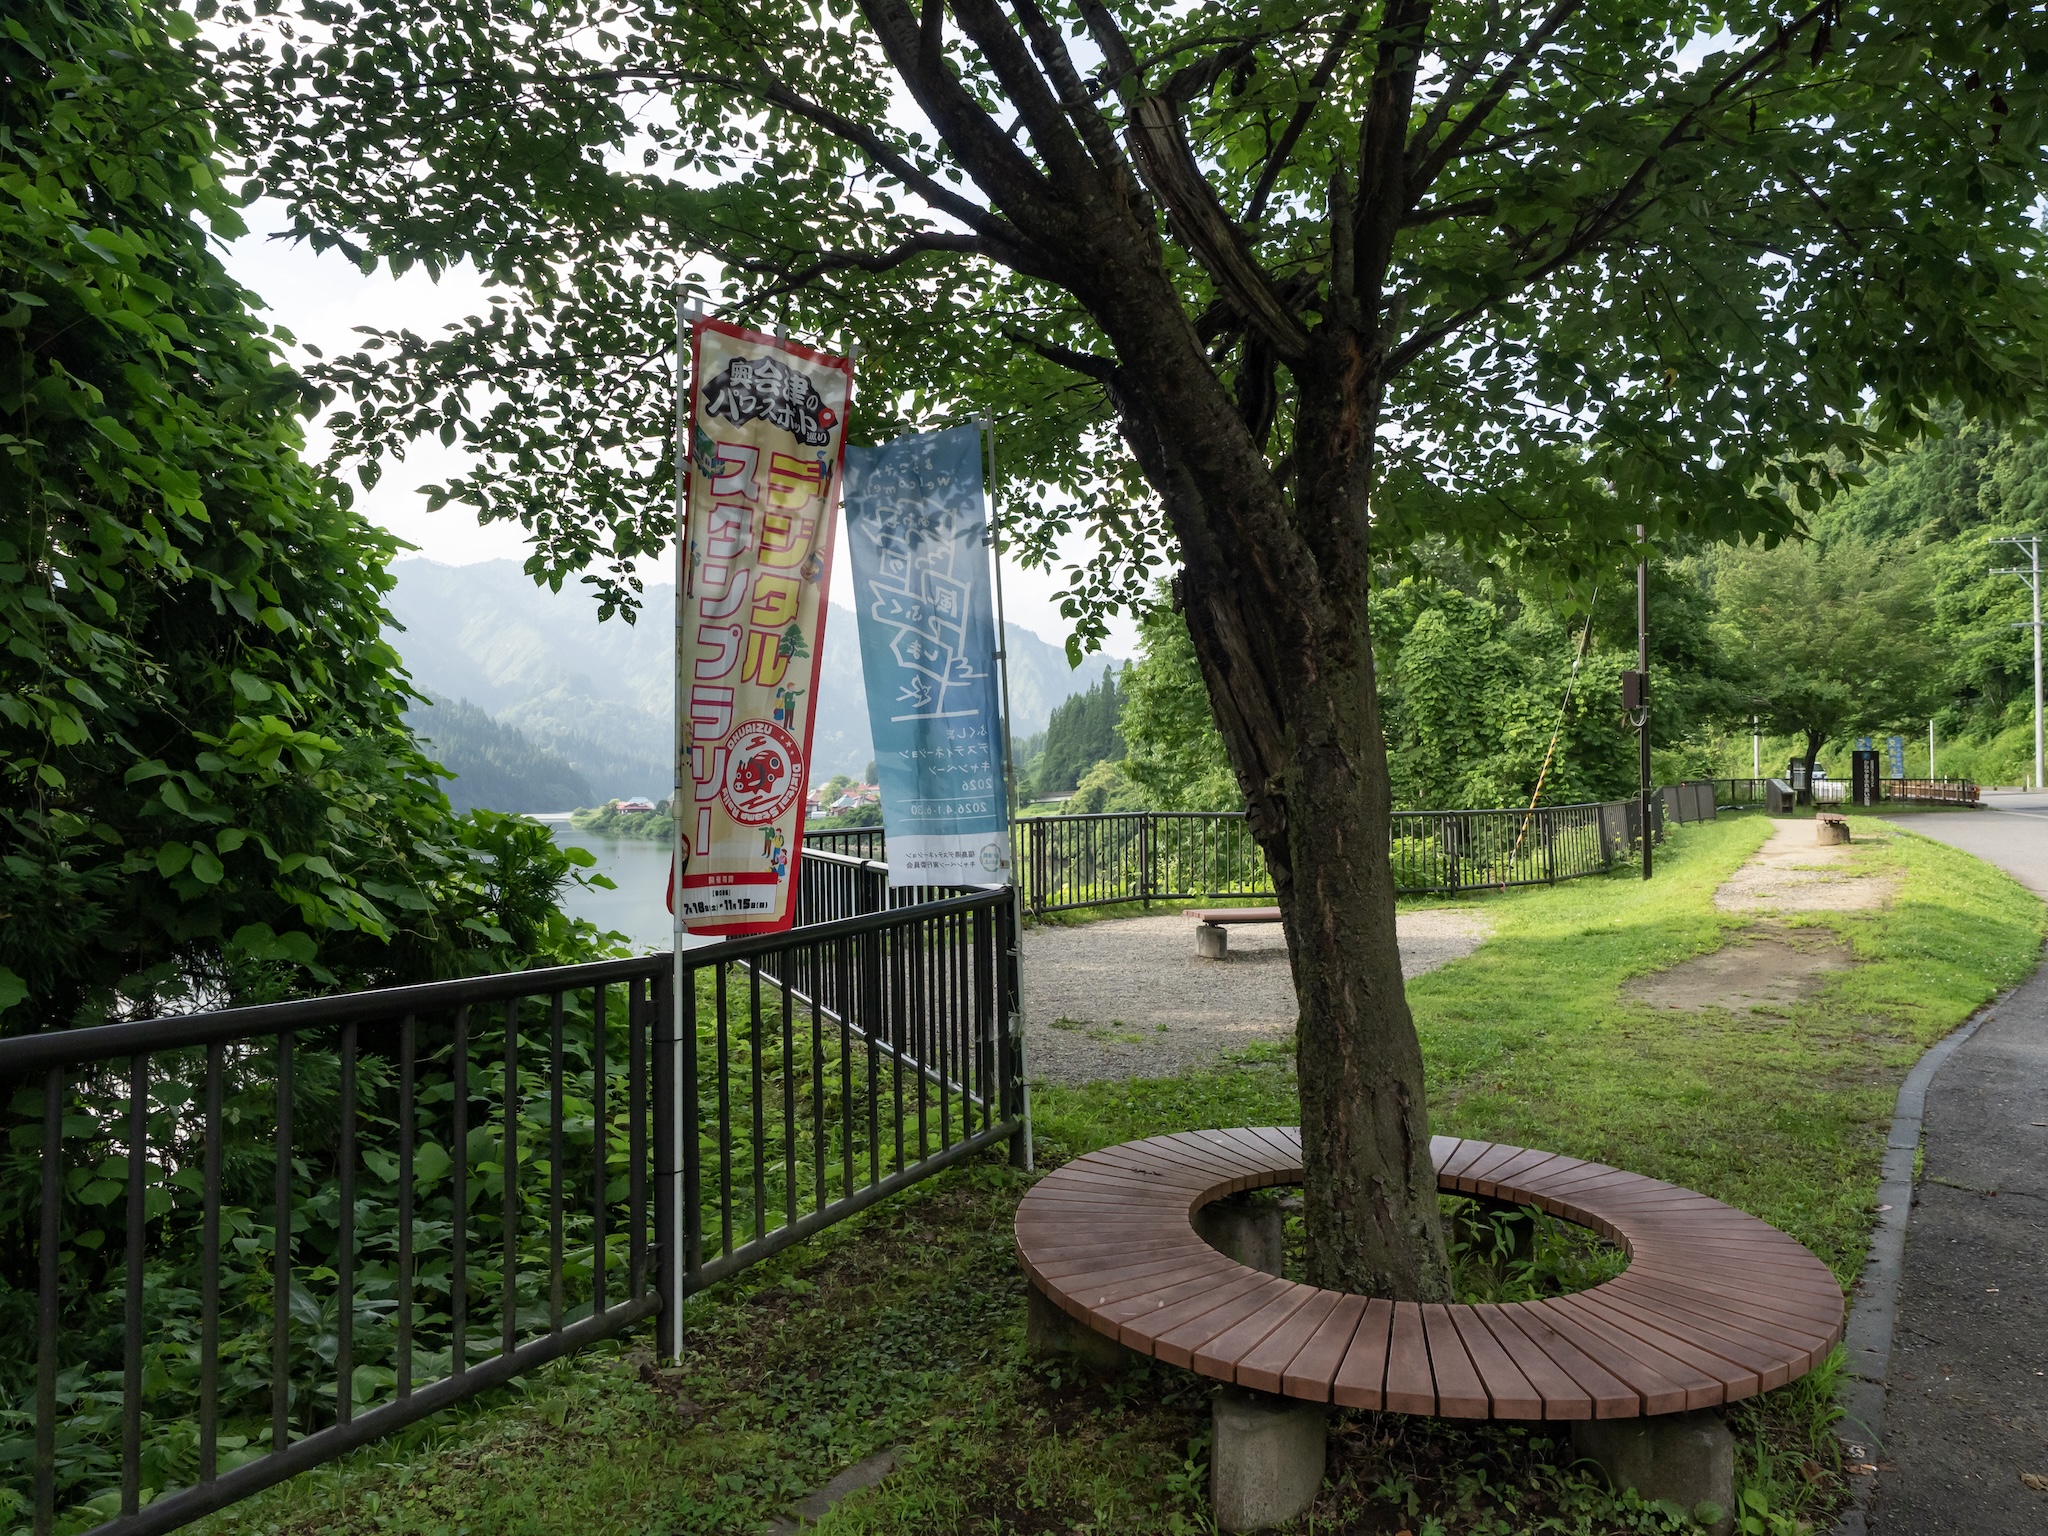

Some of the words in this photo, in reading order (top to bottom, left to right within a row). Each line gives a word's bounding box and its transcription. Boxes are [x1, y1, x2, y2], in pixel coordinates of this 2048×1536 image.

[730, 359, 819, 410] 奥会津の
[708, 388, 818, 436] パワースポット
[806, 432, 827, 444] 巡り
[741, 452, 822, 688] デジタル
[690, 440, 761, 856] スタンプラリー
[727, 723, 773, 751] OKUAIZU
